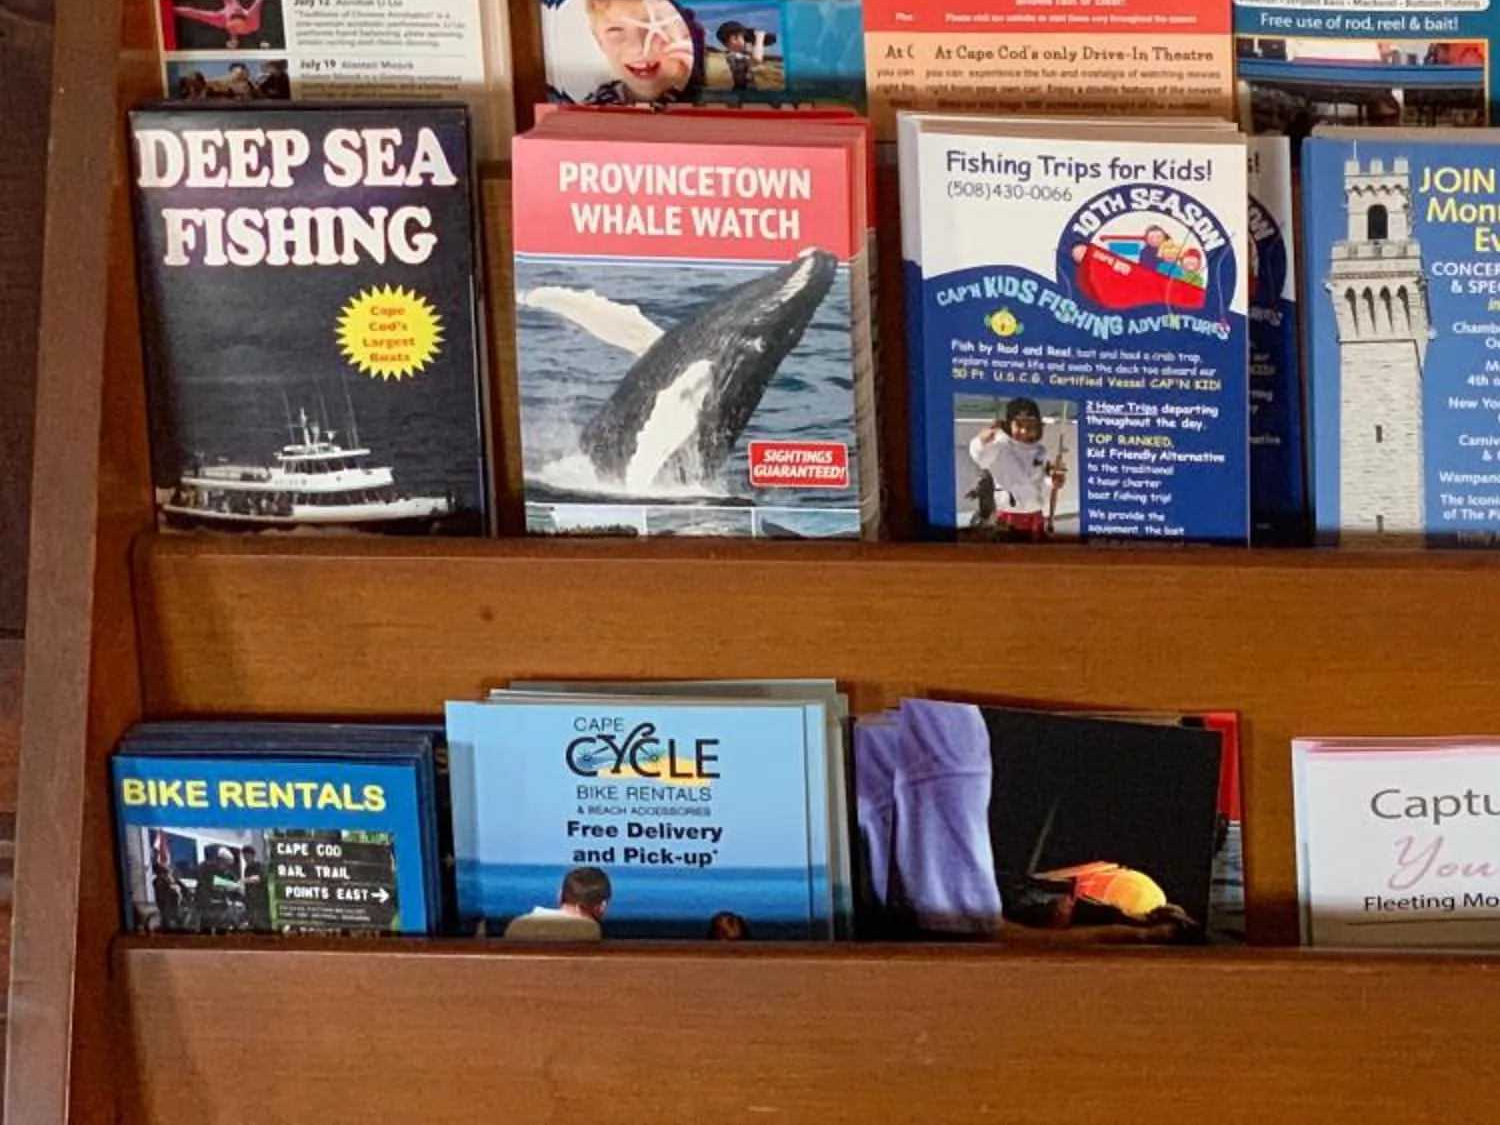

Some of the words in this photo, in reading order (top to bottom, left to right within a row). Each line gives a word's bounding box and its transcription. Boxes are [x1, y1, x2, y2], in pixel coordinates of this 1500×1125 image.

[137, 129, 310, 188] DEEP
[323, 129, 457, 188] SEA
[947, 151, 1030, 180] Fishing
[1037, 156, 1101, 182] Trips
[1109, 157, 1146, 180] for
[1153, 159, 1212, 182] Kids!
[559, 162, 811, 199] PROVINCETOWN
[947, 183, 1072, 201] (508)430-0066
[1419, 168, 1495, 194] JOIN
[571, 202, 683, 239] WHALE
[690, 205, 801, 240] WATCH
[163, 207, 437, 267] FISHING
[764, 449, 834, 465] SIGHTINGS
[754, 463, 847, 479] GUARANTEED!
[573, 717, 624, 732] CAPE
[566, 722, 721, 780] CYCLE
[122, 780, 208, 807] BIKE
[218, 782, 386, 811] RENTALS
[576, 786, 617, 801] BIKE
[625, 787, 711, 801] RENTALS
[567, 821, 619, 840] Free
[628, 823, 723, 844] Delivery
[1364, 894, 1456, 912] Fleeting
